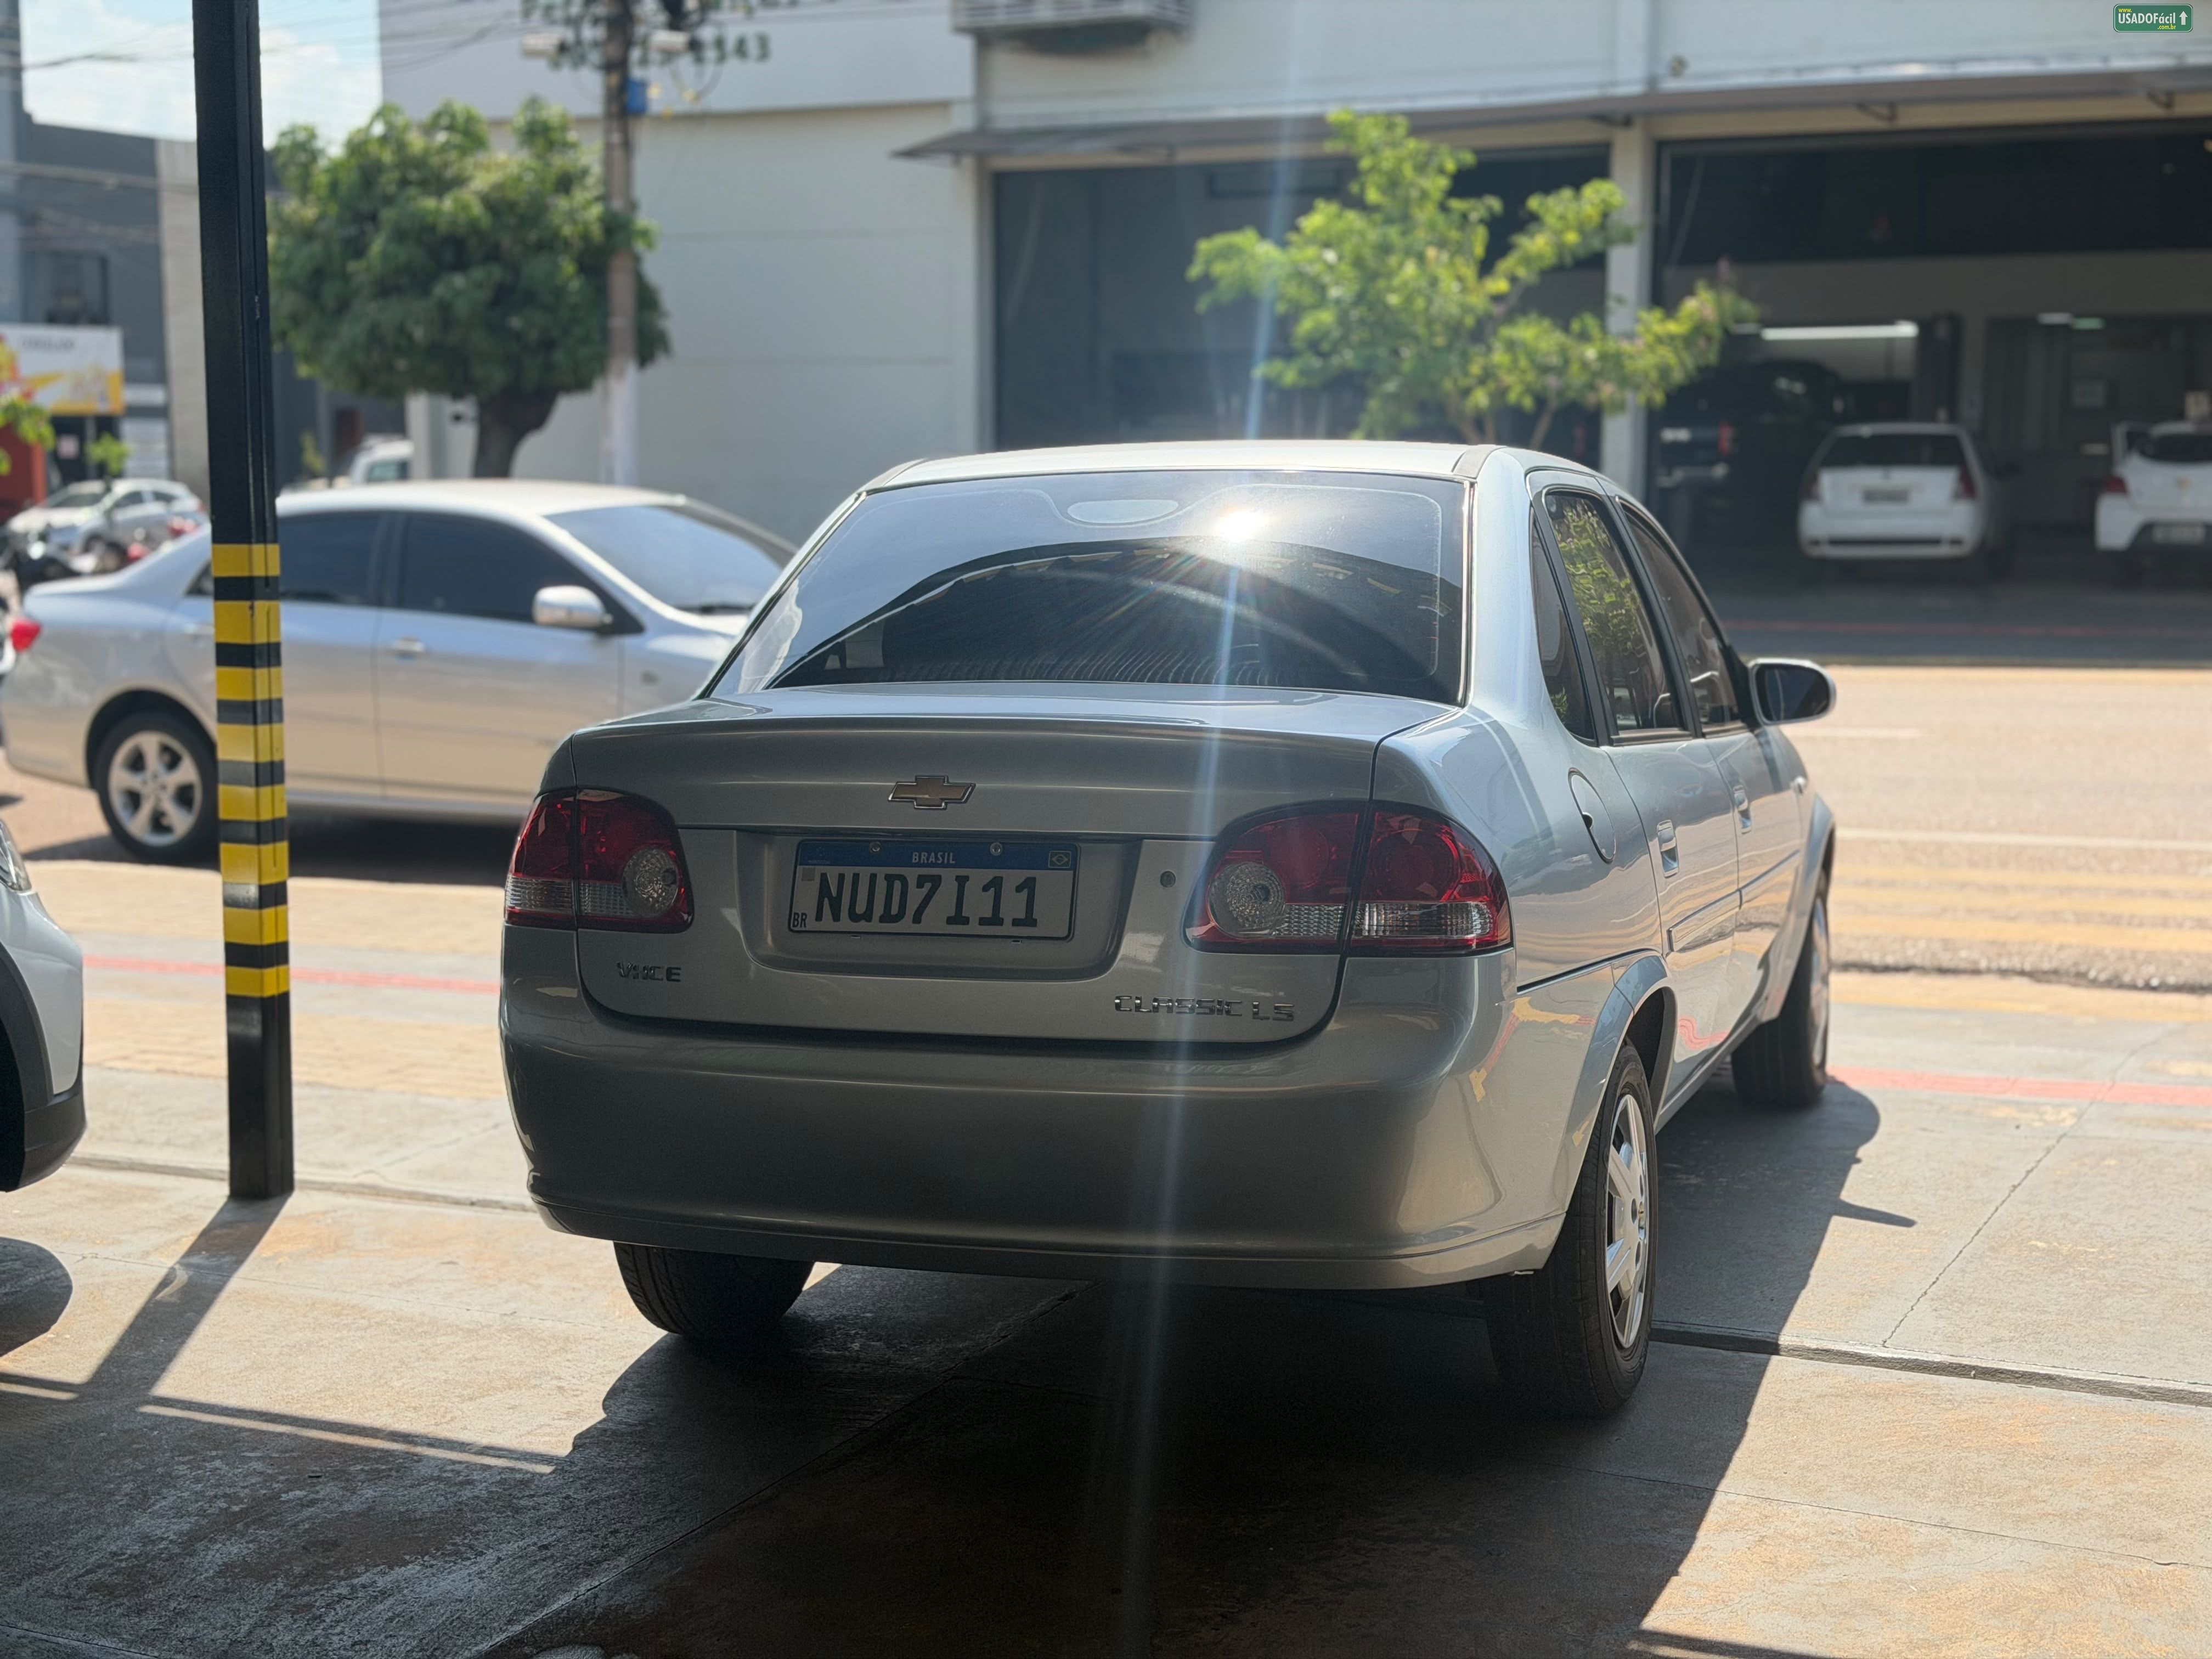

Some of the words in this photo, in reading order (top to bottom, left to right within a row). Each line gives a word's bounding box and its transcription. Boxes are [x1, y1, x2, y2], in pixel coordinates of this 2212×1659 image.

[912, 851, 956, 865] BRASIL
[815, 872, 1038, 927] NUD7I11
[792, 912, 807, 929] BR
[1114, 995, 1243, 1016] CLASSIC
[1251, 1001, 1295, 1022] LS
